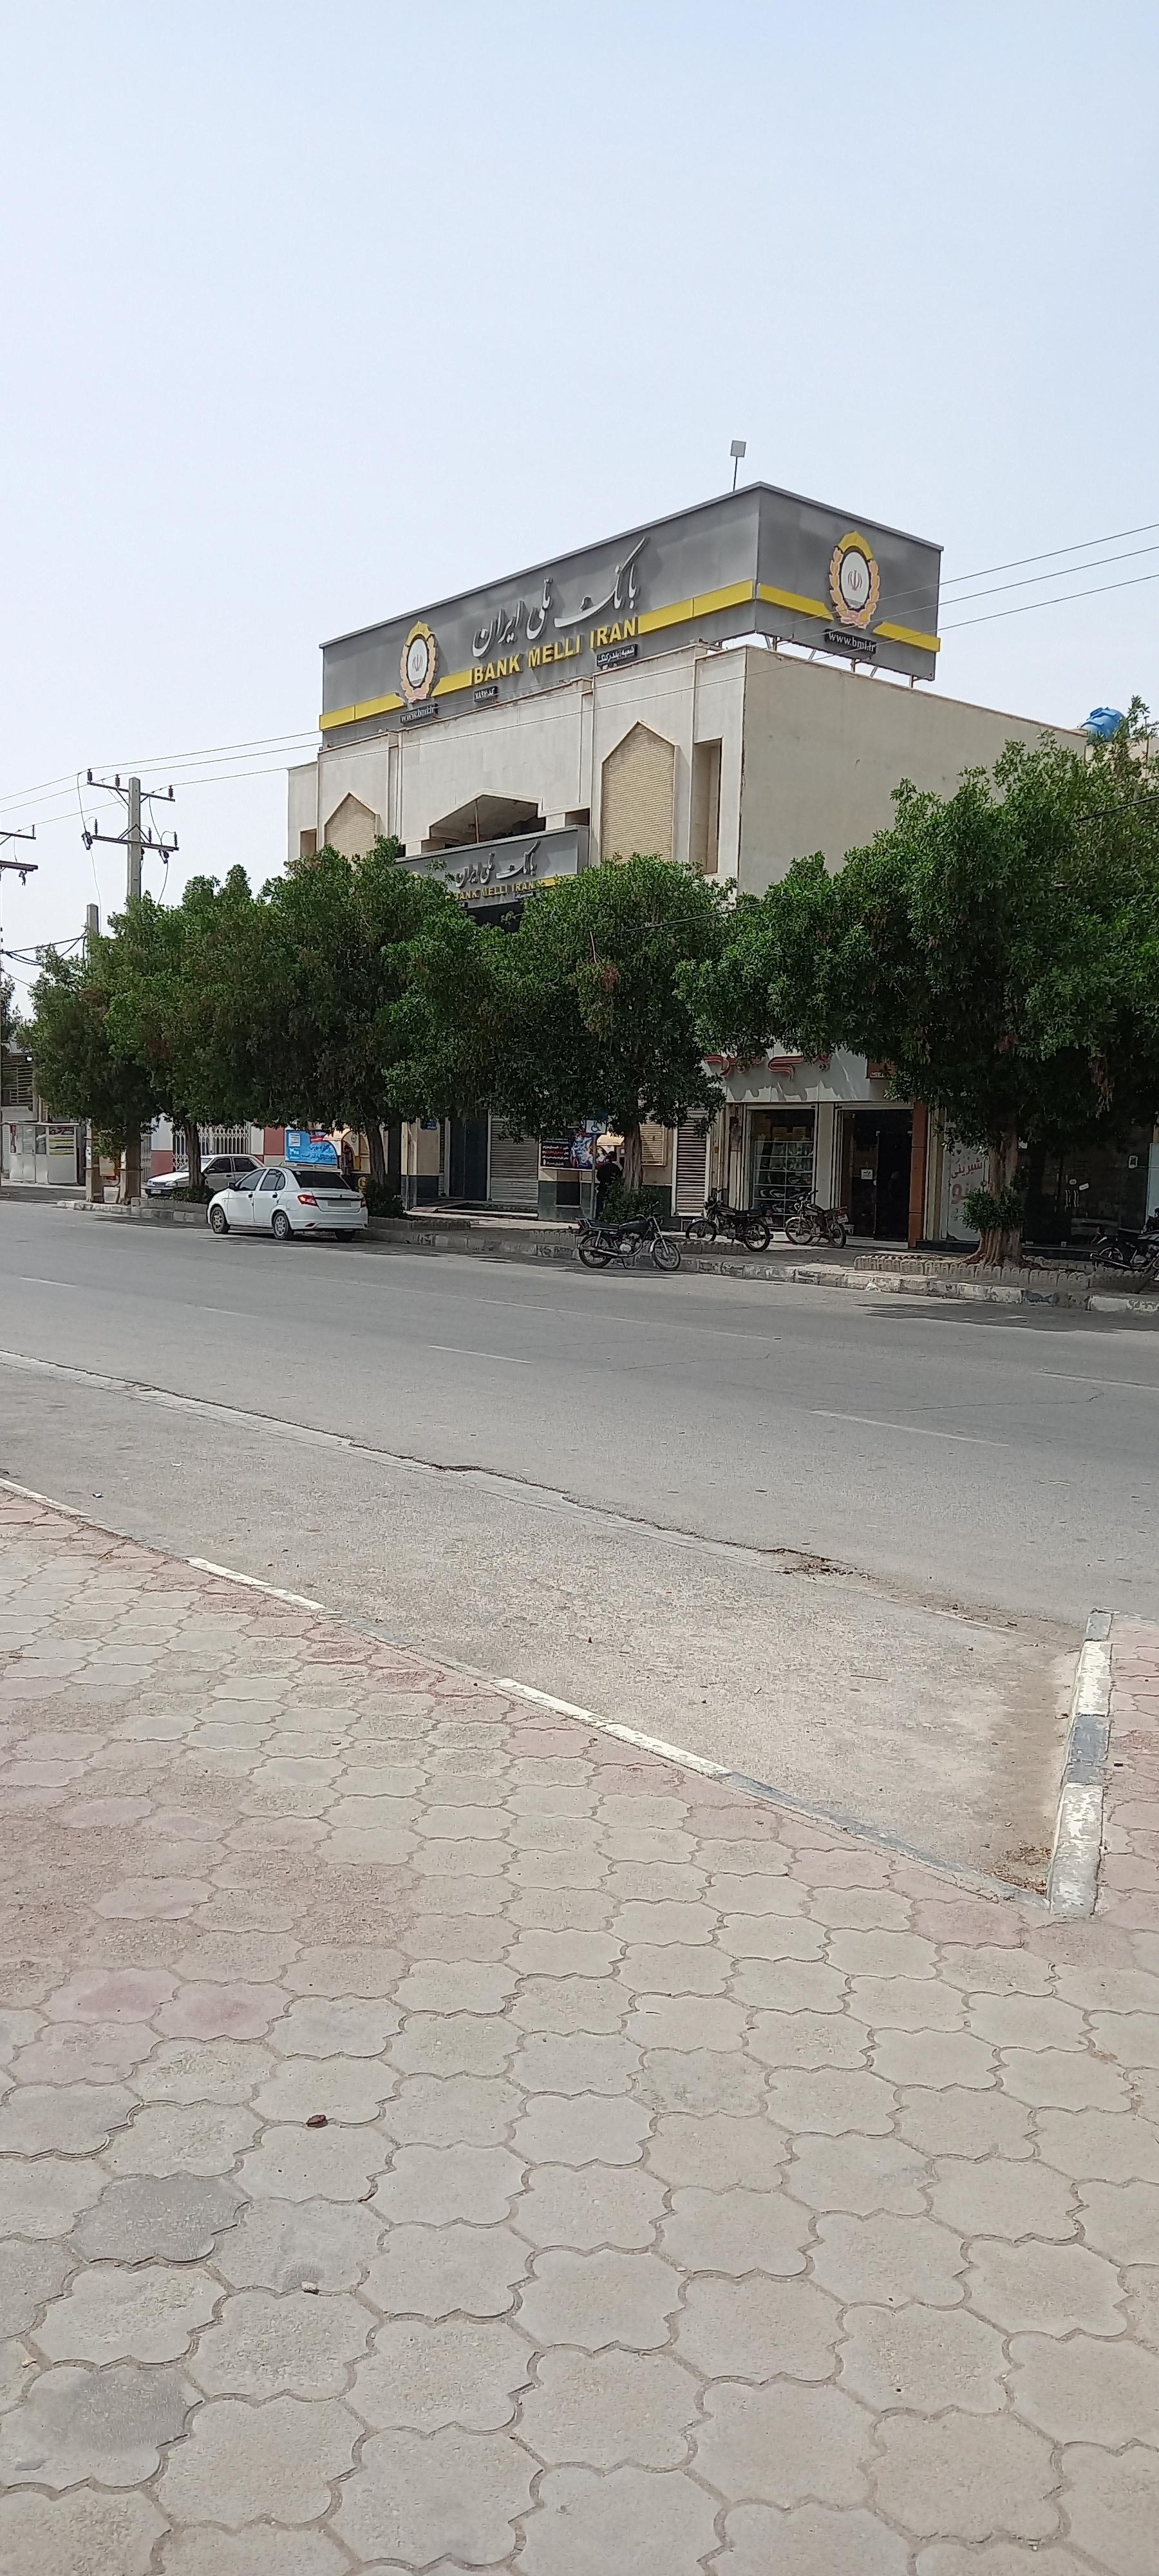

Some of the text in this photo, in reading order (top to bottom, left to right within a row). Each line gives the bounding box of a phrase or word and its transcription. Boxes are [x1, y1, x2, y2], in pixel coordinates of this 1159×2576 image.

[554, 536, 646, 629] بانک
[472, 600, 523, 658] ایران
[828, 632, 876, 652] www.bmi.ir
[474, 616, 638, 685] BANK MELLI IRAN
[455, 862, 482, 888] ایران
[496, 840, 541, 880] بانک
[482, 885, 509, 896] MELLI
[512, 882, 535, 892] IRAN
[952, 1158, 983, 1179] شیرینی
